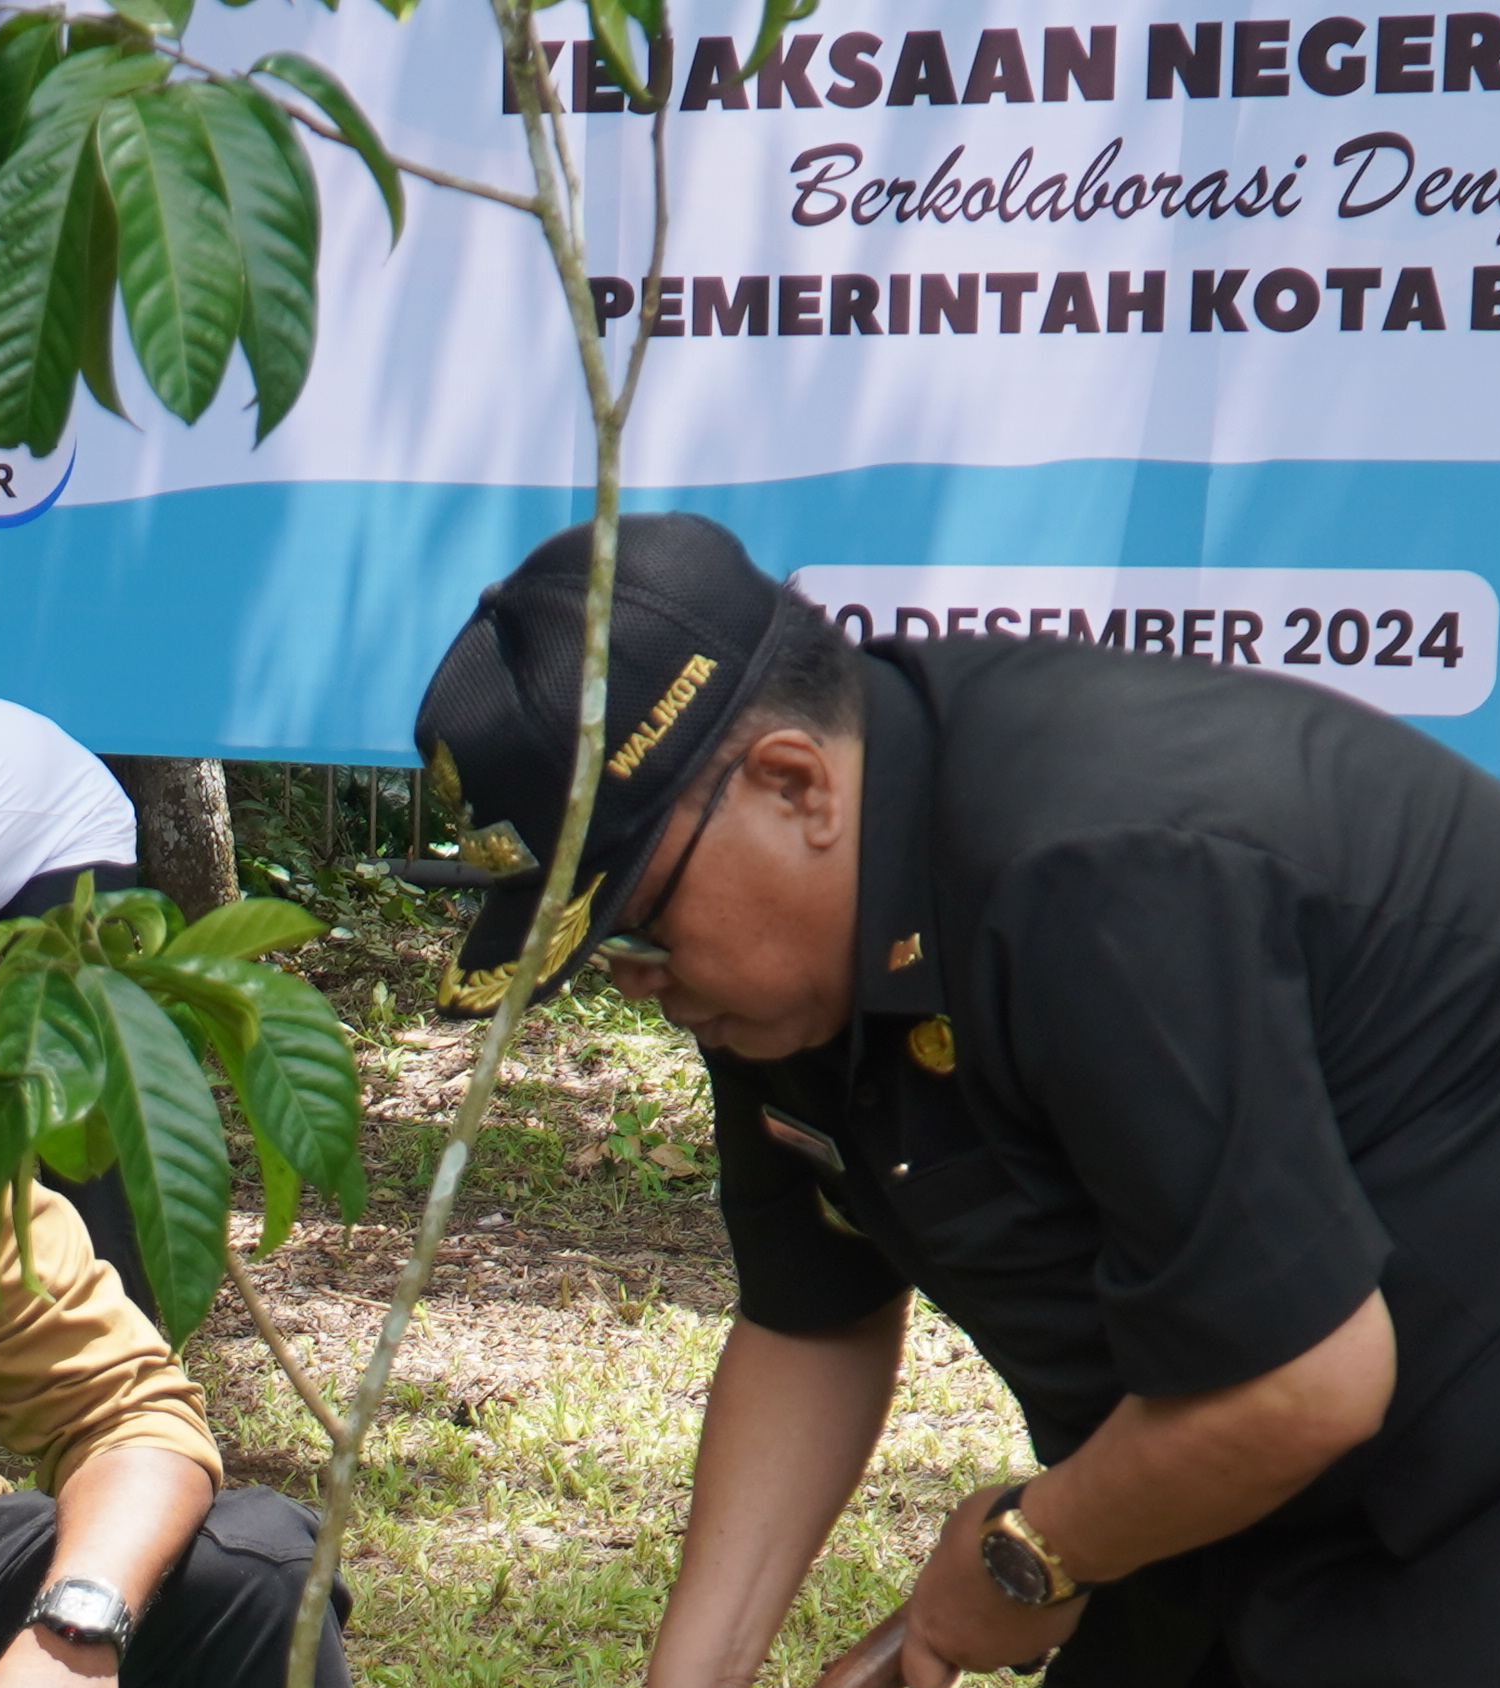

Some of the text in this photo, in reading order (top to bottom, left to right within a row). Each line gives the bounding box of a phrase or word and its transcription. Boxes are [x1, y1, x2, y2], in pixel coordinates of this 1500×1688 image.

[502, 25, 1118, 116] KEJAKSAAN
[789, 137, 1308, 226] Berkolaborasi
[588, 271, 1167, 338] PEMERINTAH
[1189, 267, 1447, 334] KOTA
[1282, 607, 1466, 669] 2024
[606, 653, 719, 780] WALIKOTA
